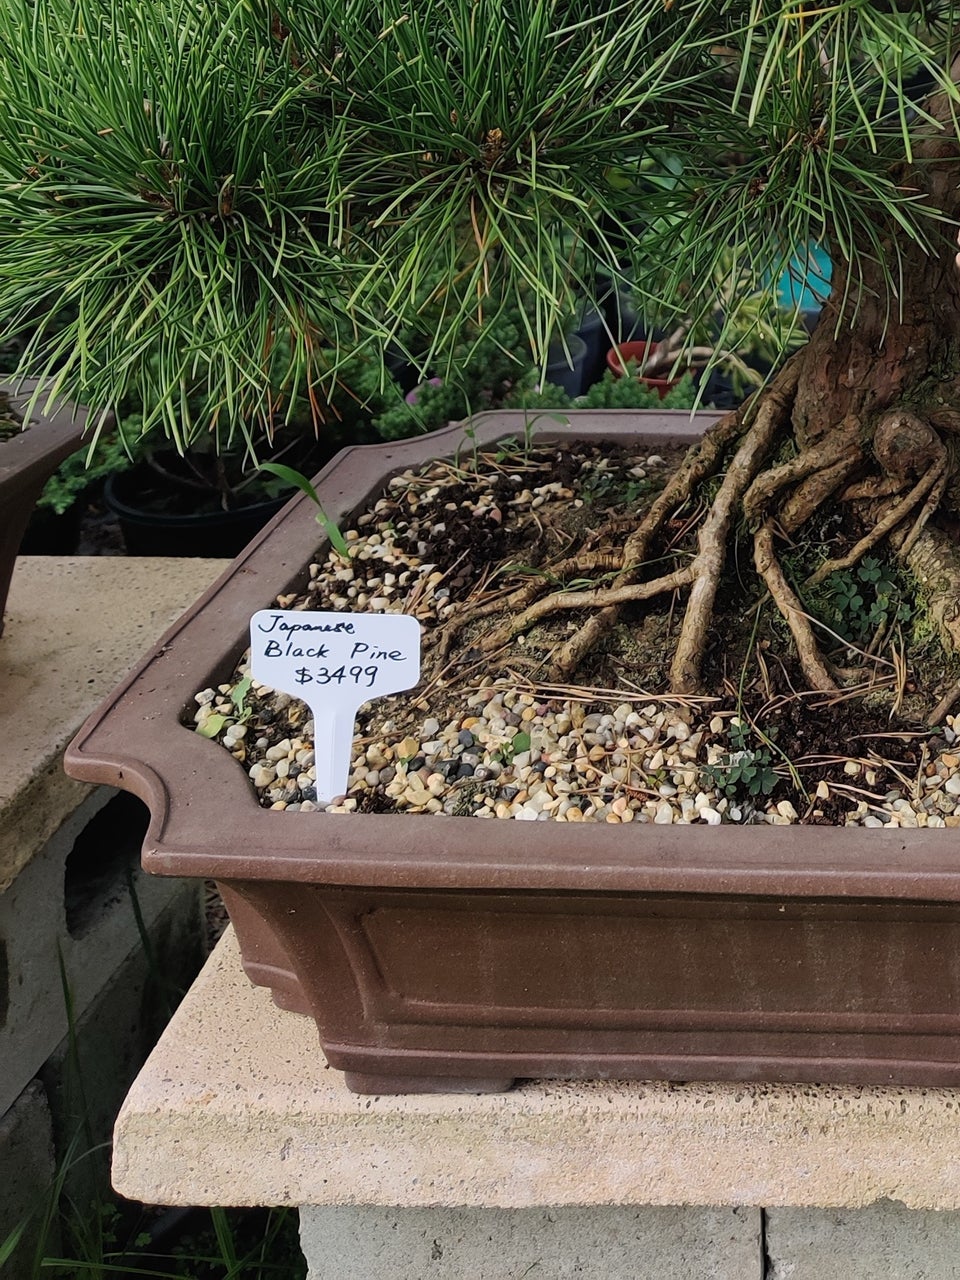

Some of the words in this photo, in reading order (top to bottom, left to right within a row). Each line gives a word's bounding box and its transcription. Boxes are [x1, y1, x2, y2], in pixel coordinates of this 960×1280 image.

[258, 615, 355, 641] Japanese
[264, 640, 330, 658] Black
[350, 642, 407, 661] Pine
[295, 665, 378, 687] $3499
